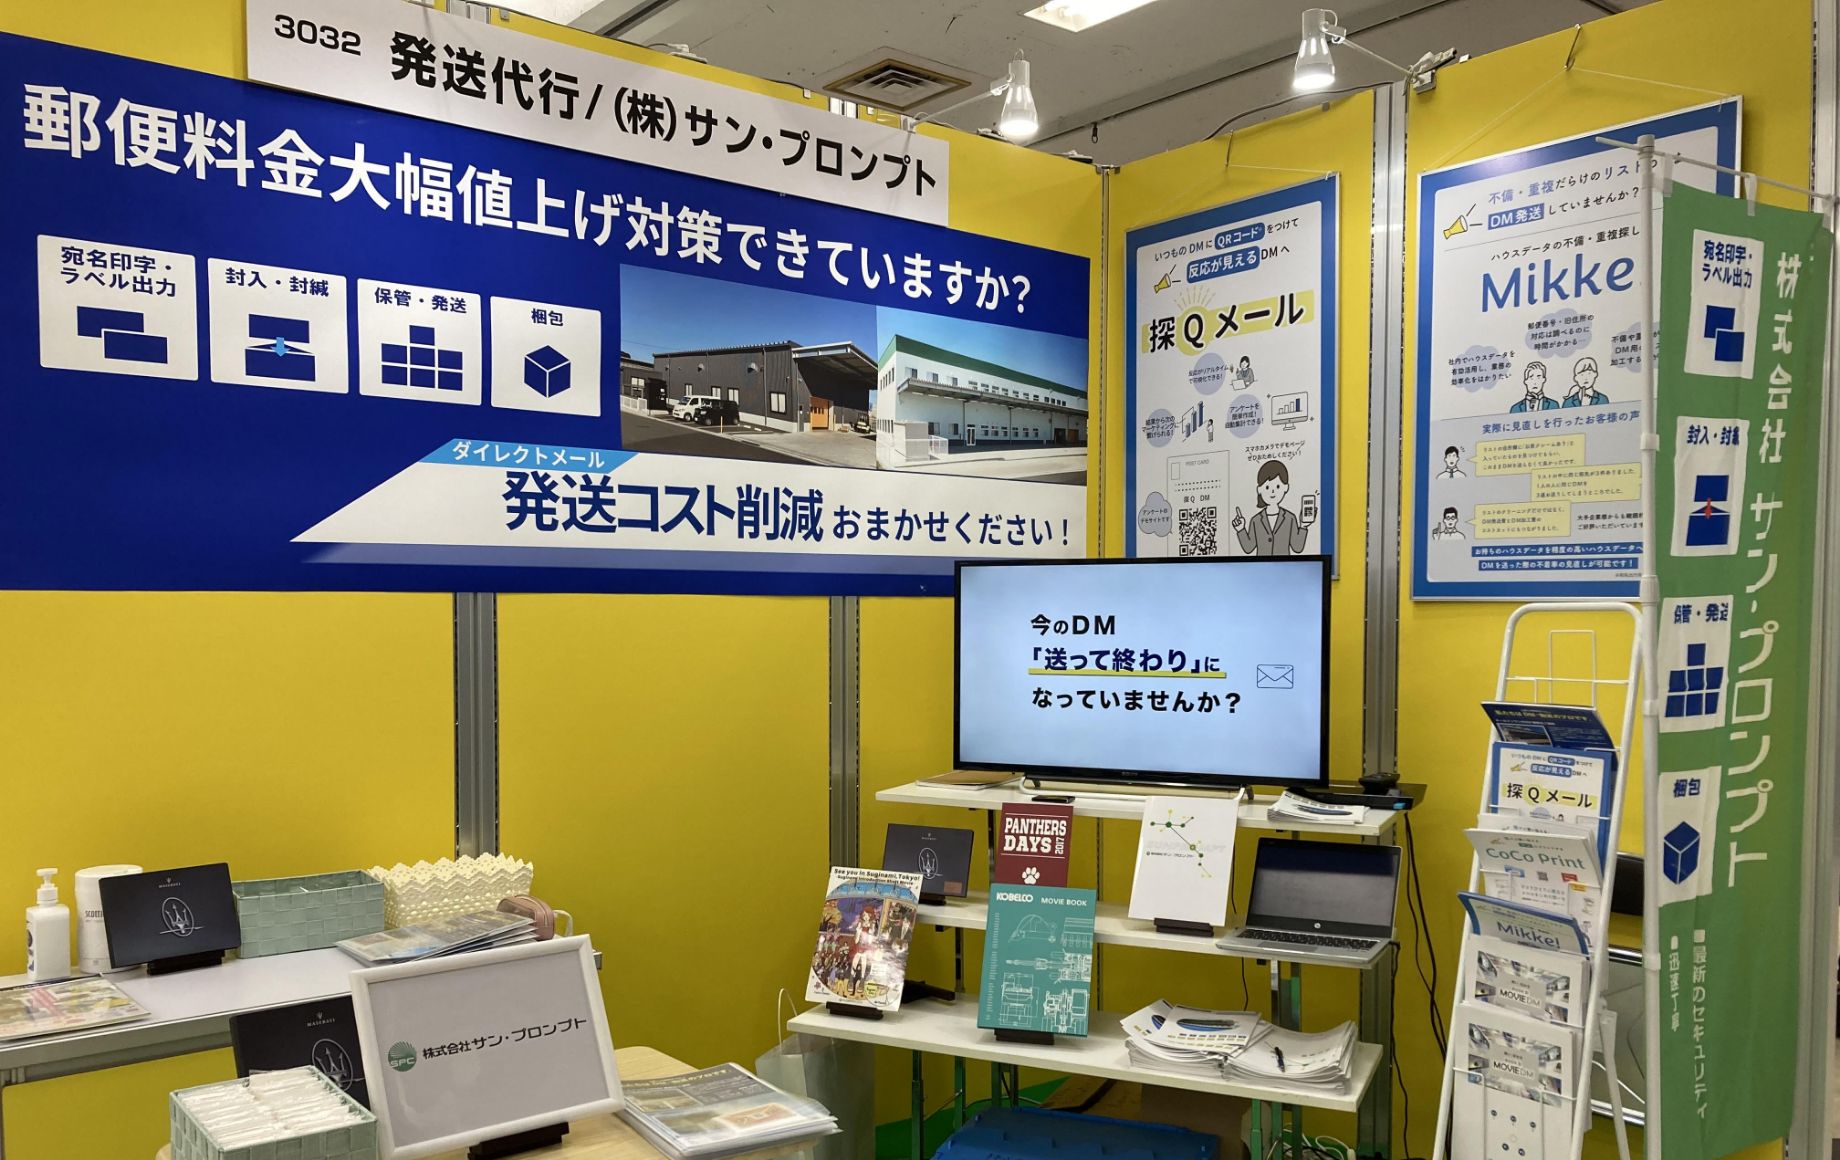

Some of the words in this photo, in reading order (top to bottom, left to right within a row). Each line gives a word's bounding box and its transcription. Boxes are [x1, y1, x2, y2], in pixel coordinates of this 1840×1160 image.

[274, 14, 362, 56] 3032
[23, 83, 1032, 315] 郵便料金大幅値上げ対策できていますか?
[60, 266, 176, 297] ラベル出力
[225, 267, 330, 298] 封入・封緘
[1702, 263, 1752, 289] ラベル出力
[374, 287, 466, 314] 保管・発送
[531, 308, 563, 327] 梱包
[1482, 411, 1640, 435] 実際に見直しを行ったお客様の声
[453, 441, 606, 469] ダイレクトメール
[1030, 614, 1116, 636] 今のDM
[1033, 647, 1221, 675] 「送って終わり」に
[1031, 686, 1242, 714] なっていませんか?
[1673, 778, 1701, 798] 梱包
[1004, 817, 1067, 836] PANTHERS
[1003, 834, 1052, 854] DAYS
[1054, 837, 1064, 855] 2017
[1486, 847, 1534, 863] CoCo
[1539, 853, 1586, 870] Print
[996, 892, 1034, 903] KOBELCO
[1041, 897, 1064, 905] MOVIE
[1066, 898, 1088, 906] BOOK
[1497, 921, 1561, 949] Mikke!
[422, 1018, 587, 1060] 株式会社サン・プロンプト
[391, 1056, 414, 1067] SPC
